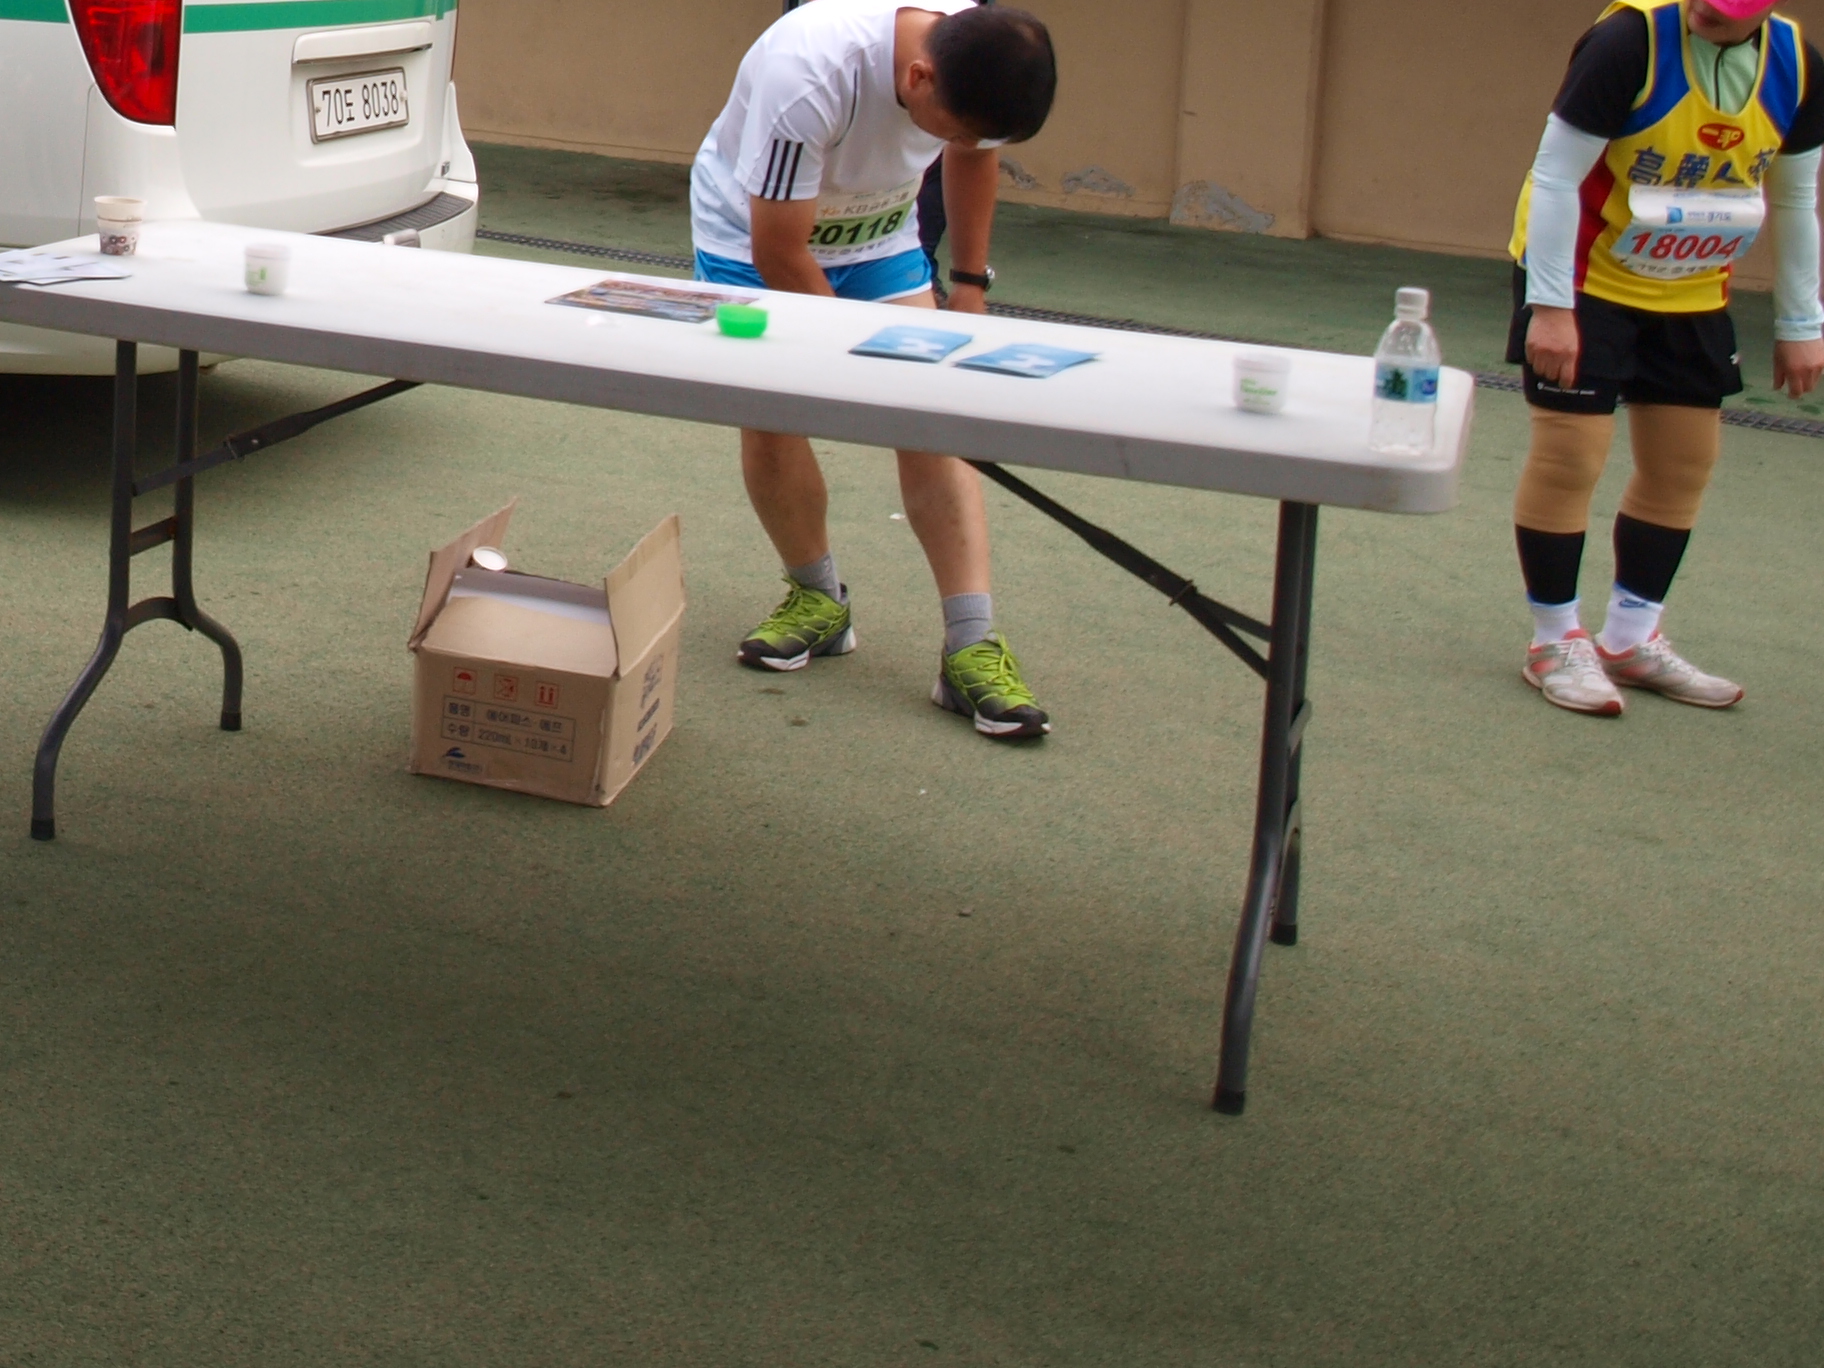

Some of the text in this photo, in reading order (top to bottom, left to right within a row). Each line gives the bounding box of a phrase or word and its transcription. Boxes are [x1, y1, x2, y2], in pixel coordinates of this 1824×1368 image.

[322, 79, 399, 127] 70도 8038
[1631, 231, 1744, 261] 18004
